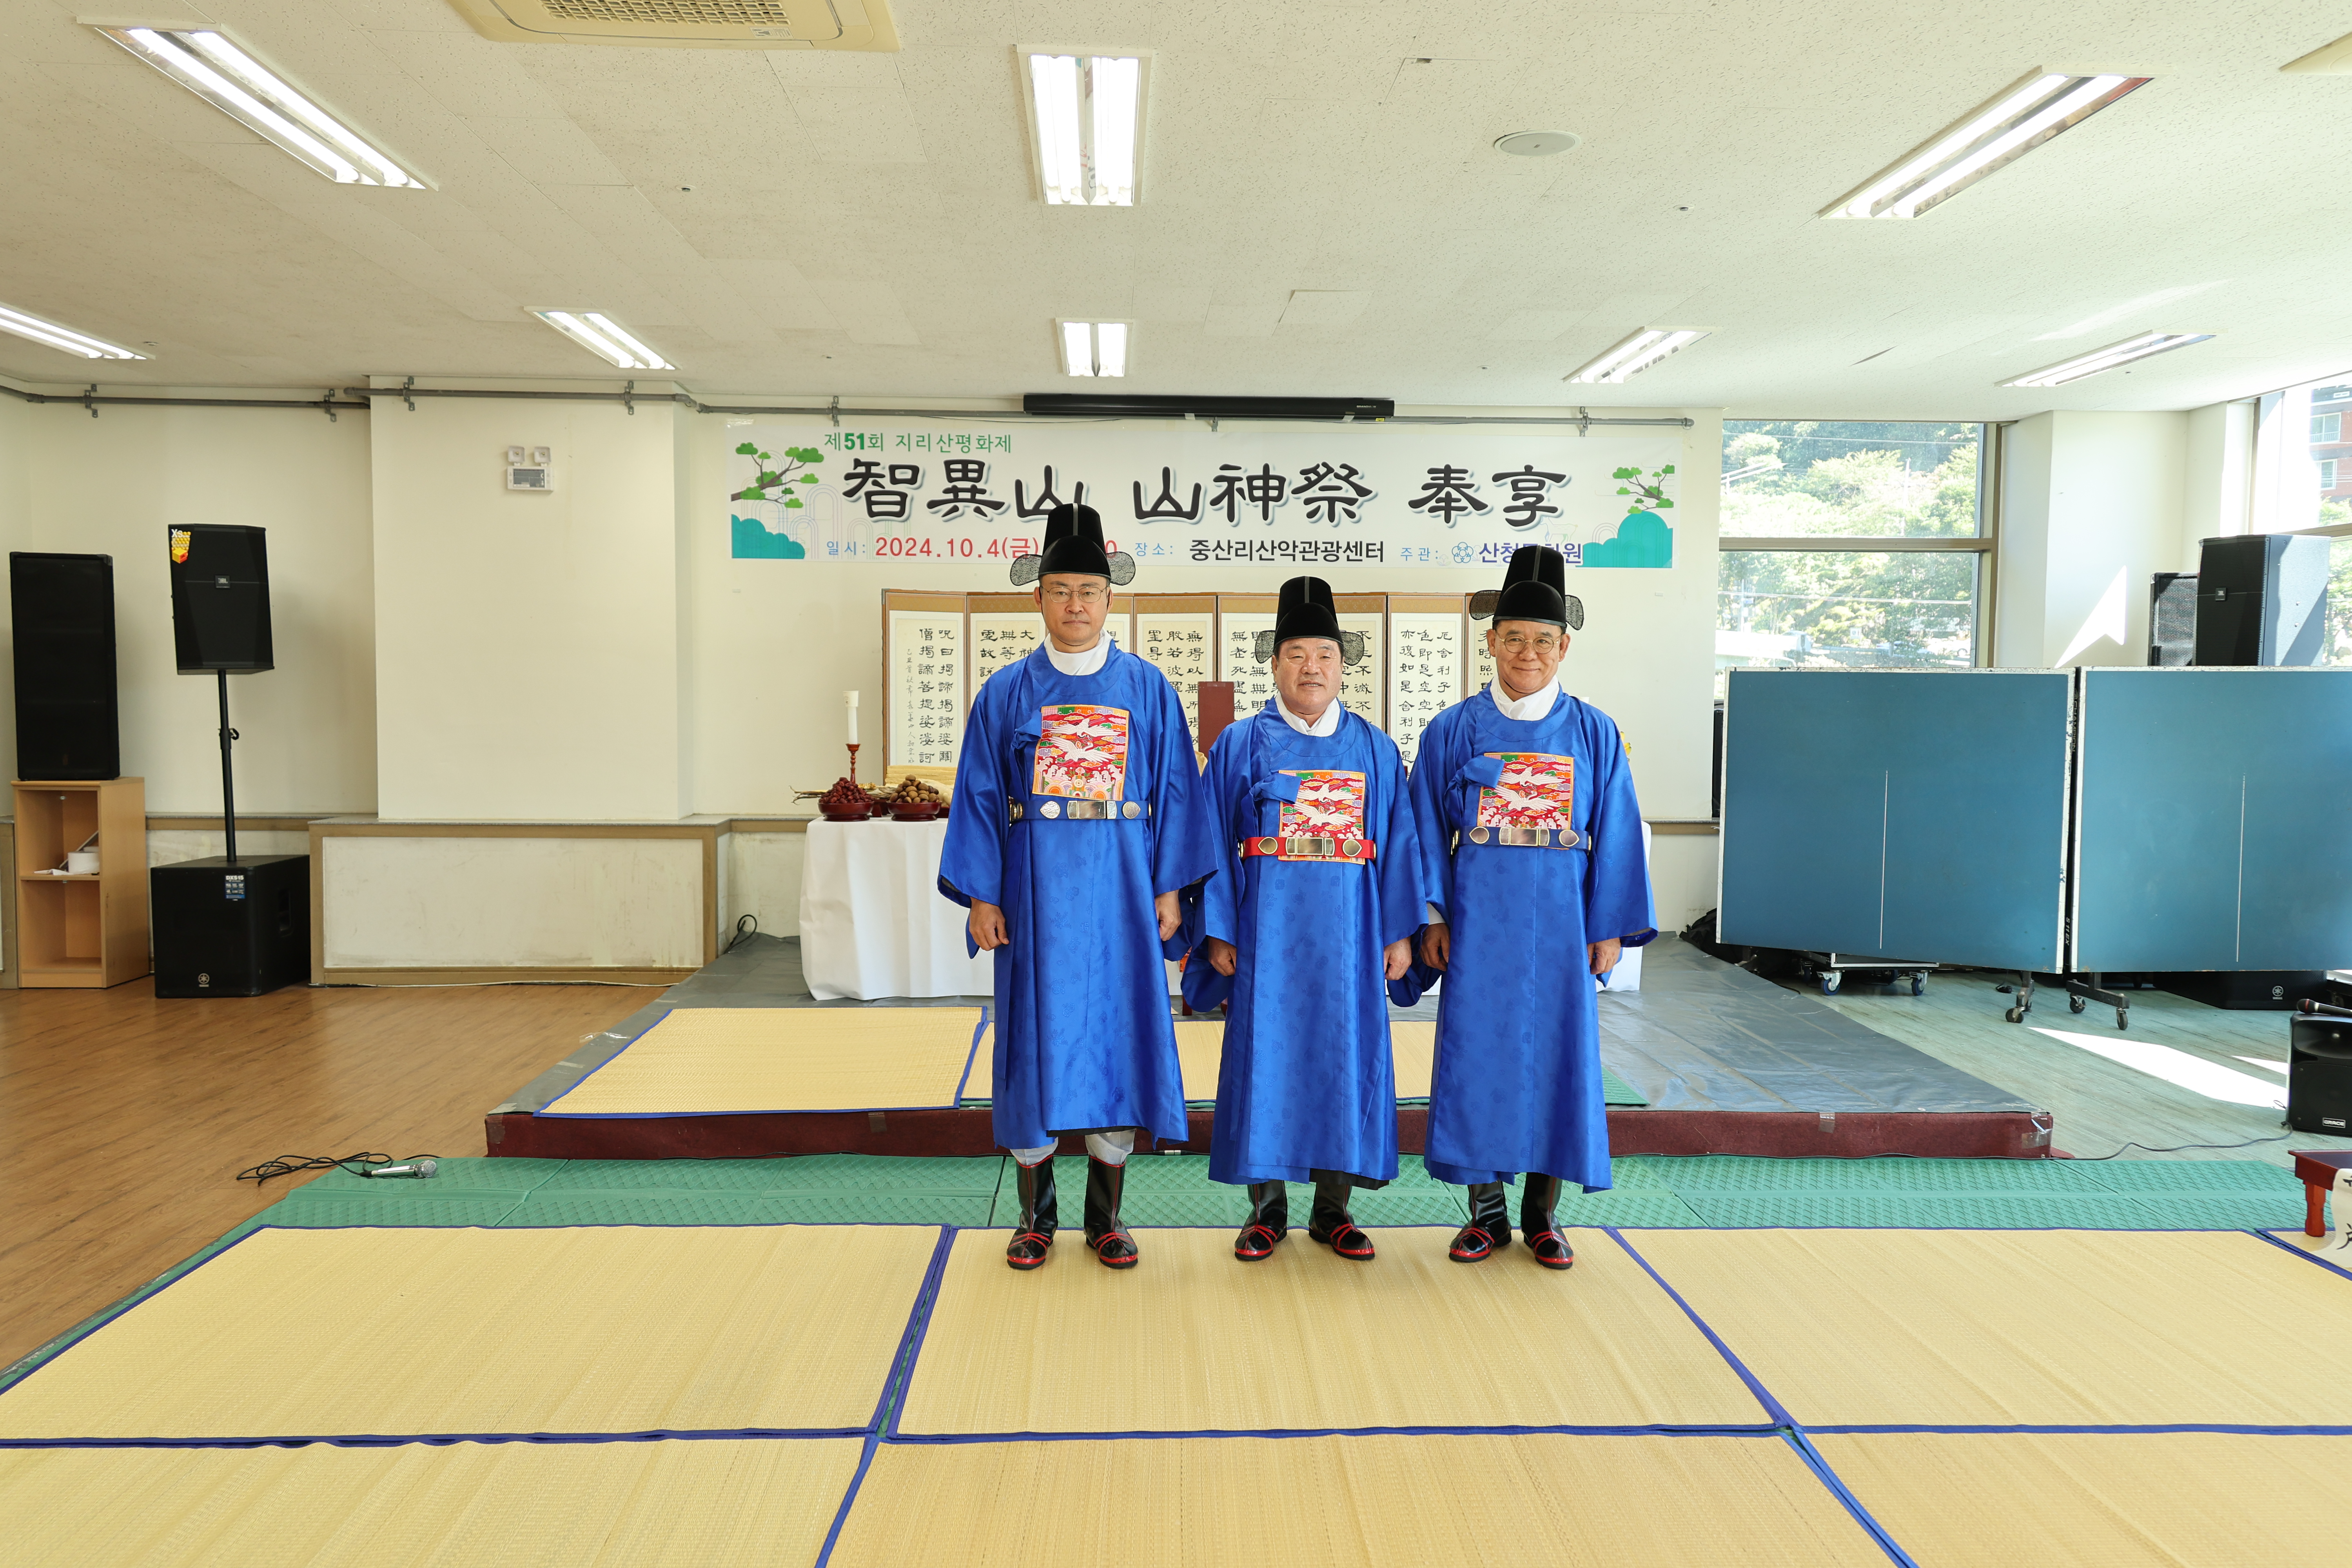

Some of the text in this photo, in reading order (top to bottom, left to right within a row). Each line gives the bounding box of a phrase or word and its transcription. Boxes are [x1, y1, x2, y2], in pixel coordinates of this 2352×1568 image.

[824, 432, 1011, 454] 제51회 지리산평화제
[843, 458, 1566, 527] 智異山 山神祭 奉享
[1189, 539, 1385, 563] 중산리산악관광센터
[1479, 542, 1582, 564] 산청원
[1000, 630, 1017, 667] 無等
